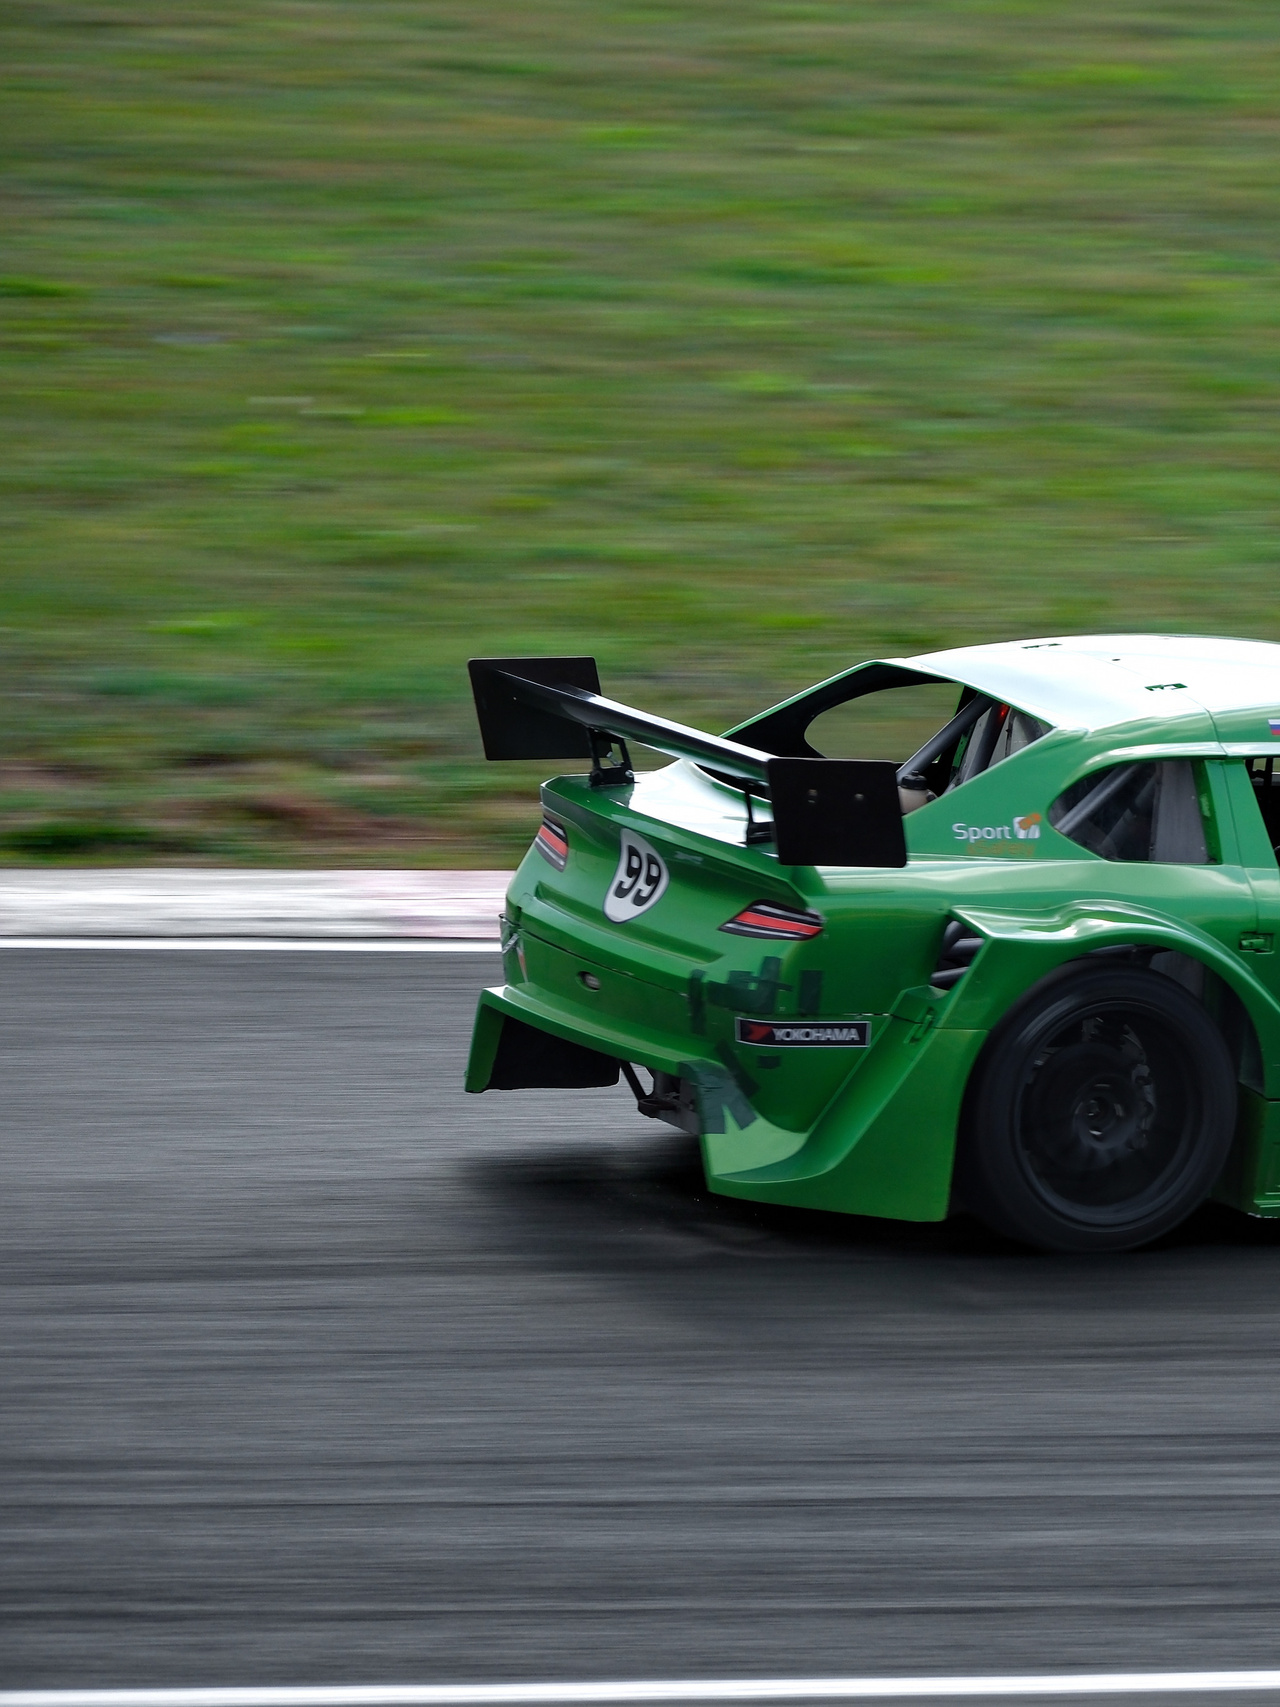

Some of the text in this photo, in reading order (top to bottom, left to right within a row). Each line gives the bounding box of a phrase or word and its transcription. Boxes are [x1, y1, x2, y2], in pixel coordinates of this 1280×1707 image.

[952, 823, 1012, 843] Sport
[614, 844, 662, 907] 99
[772, 1028, 860, 1041] YOKOHAMA
